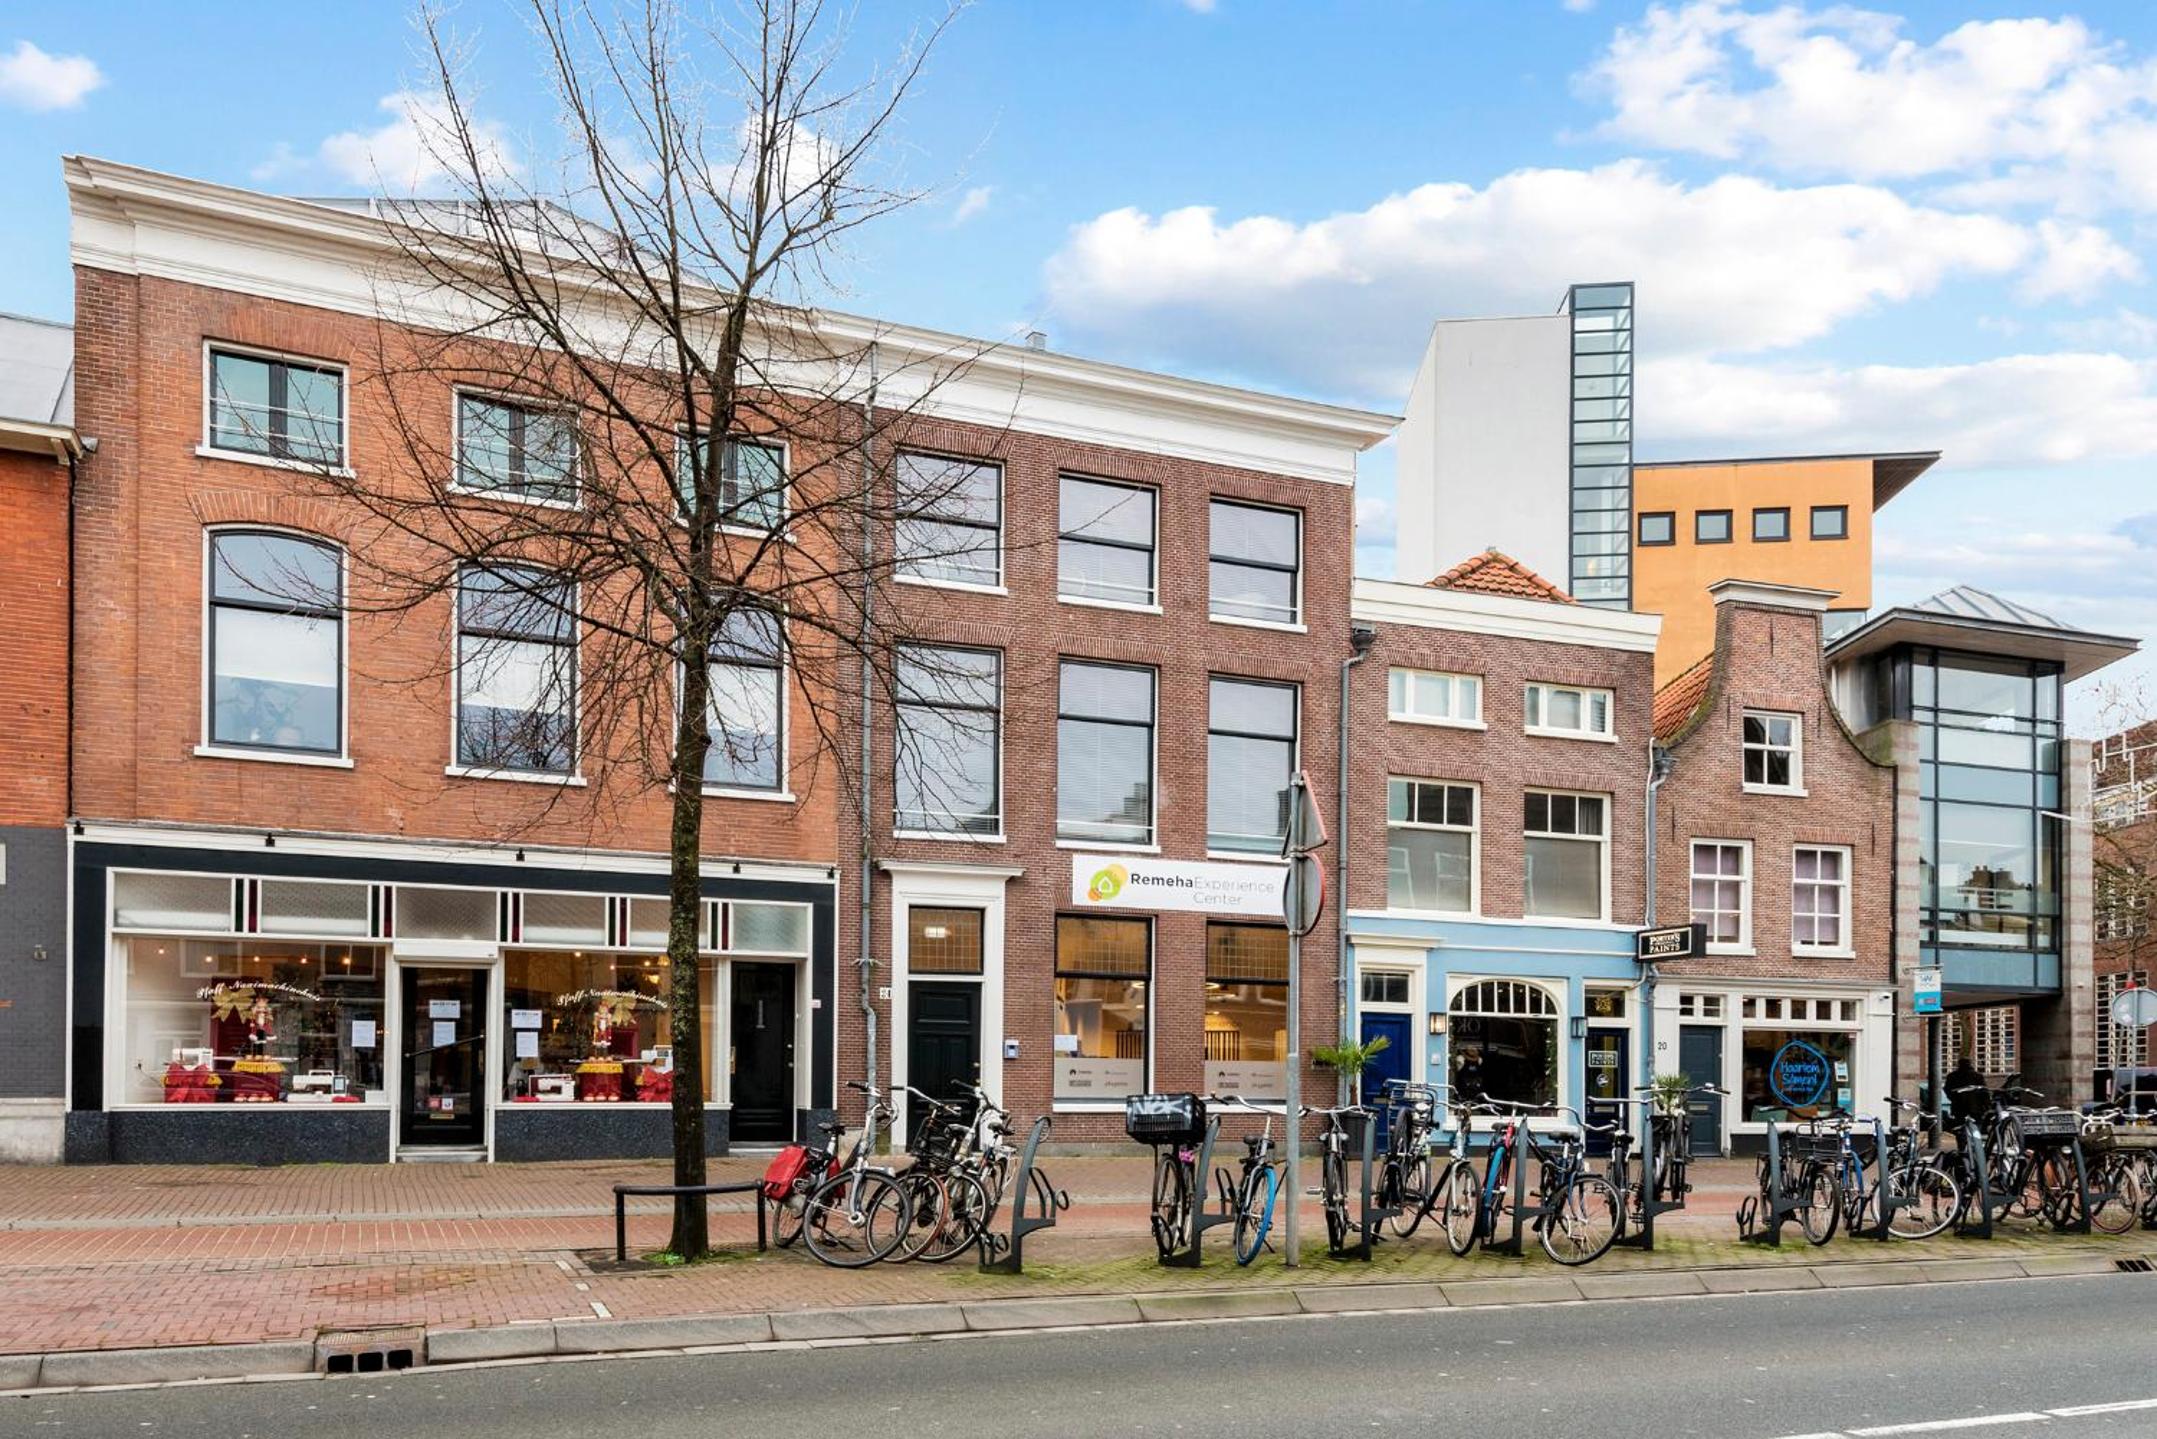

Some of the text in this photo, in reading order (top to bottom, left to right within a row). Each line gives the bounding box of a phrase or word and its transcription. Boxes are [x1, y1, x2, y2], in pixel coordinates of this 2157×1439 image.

[1193, 892, 1243, 905] Center
[1649, 944, 1681, 954] PAINTS
[1657, 1042, 1667, 1050] 20
